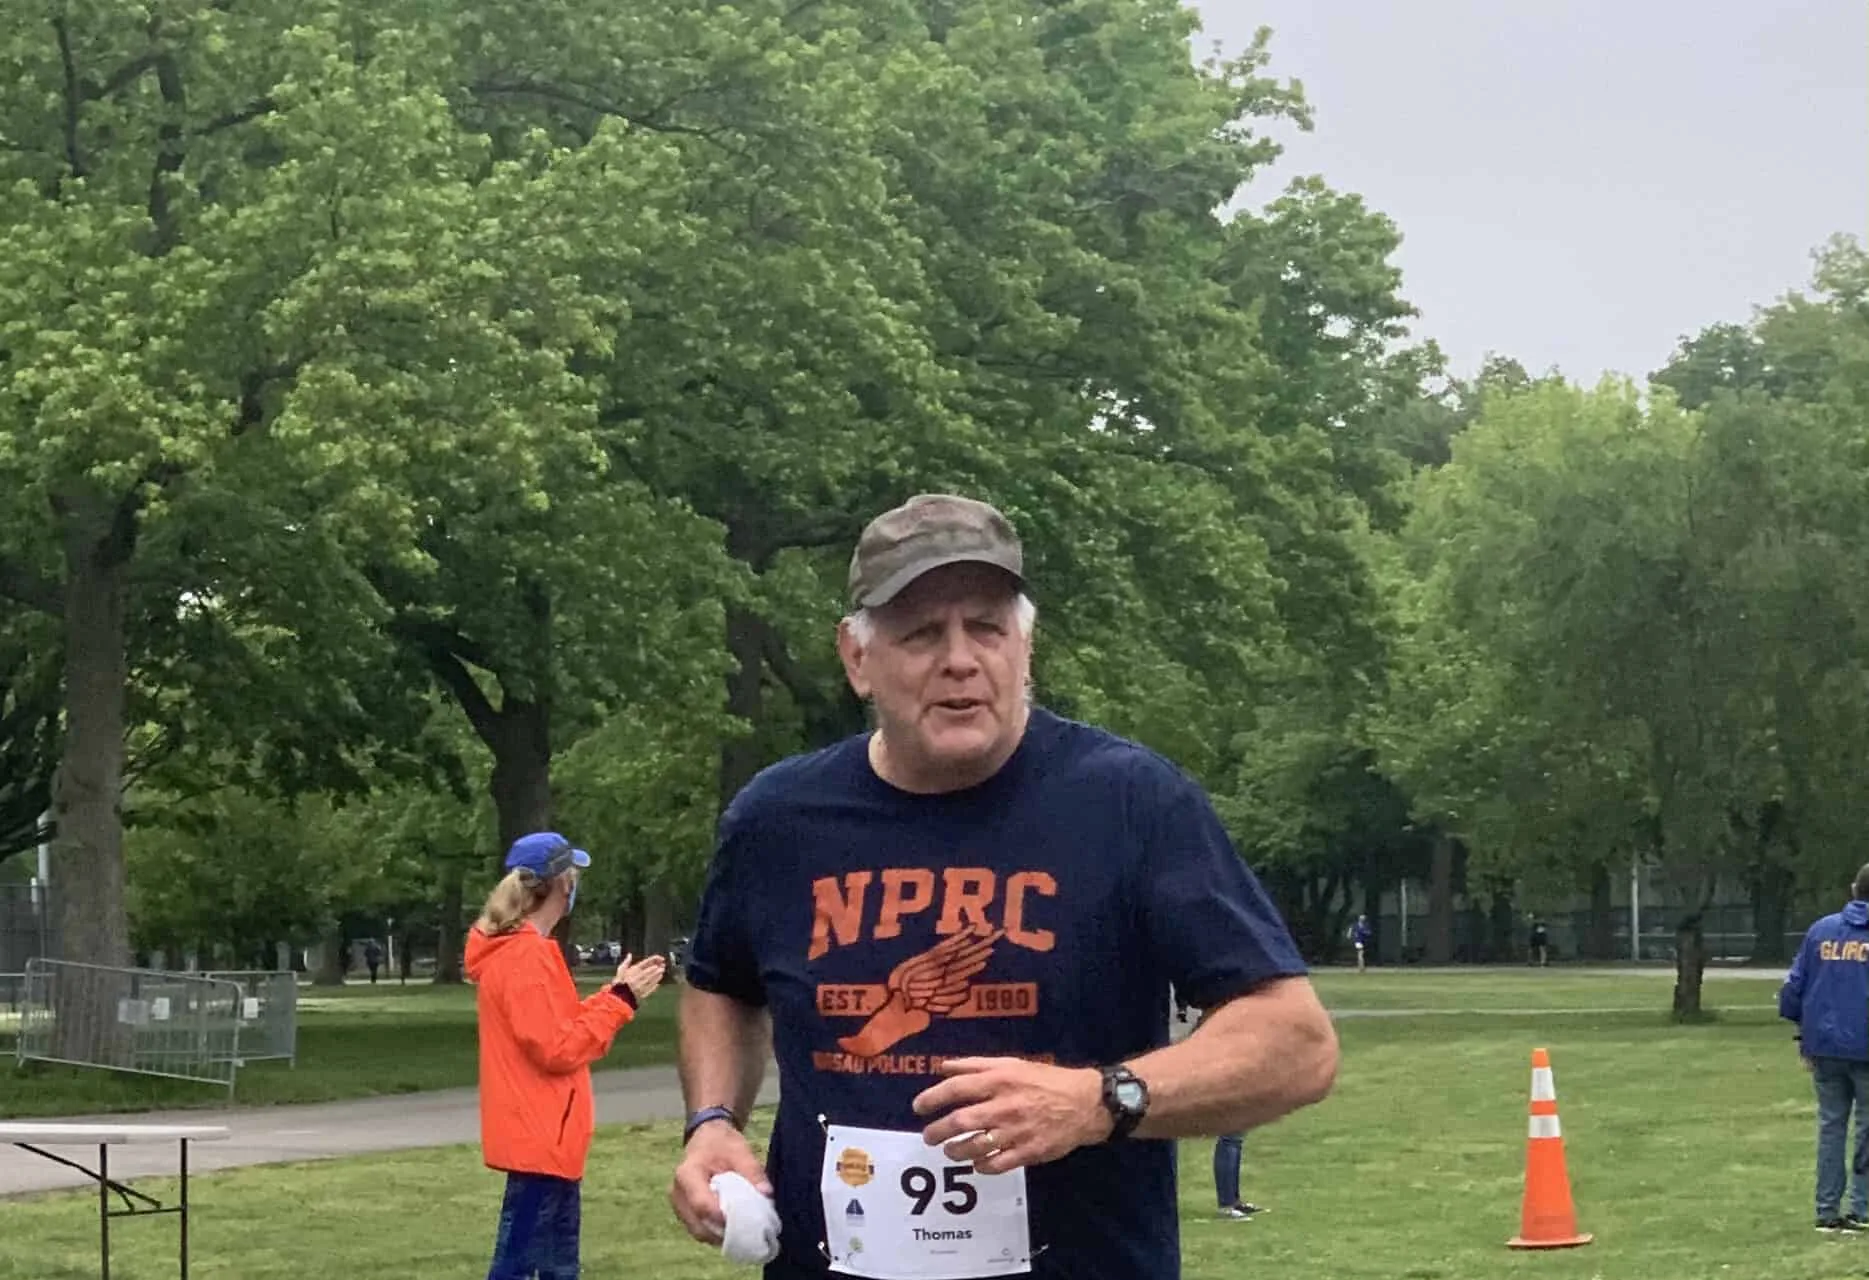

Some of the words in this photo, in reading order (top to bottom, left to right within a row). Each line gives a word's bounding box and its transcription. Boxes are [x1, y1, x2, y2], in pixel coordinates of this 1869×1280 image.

[808, 867, 1058, 961] NPRC
[867, 1055, 926, 1075] POLICE
[901, 1166, 978, 1216] 95
[912, 1228, 972, 1240] Thomas
